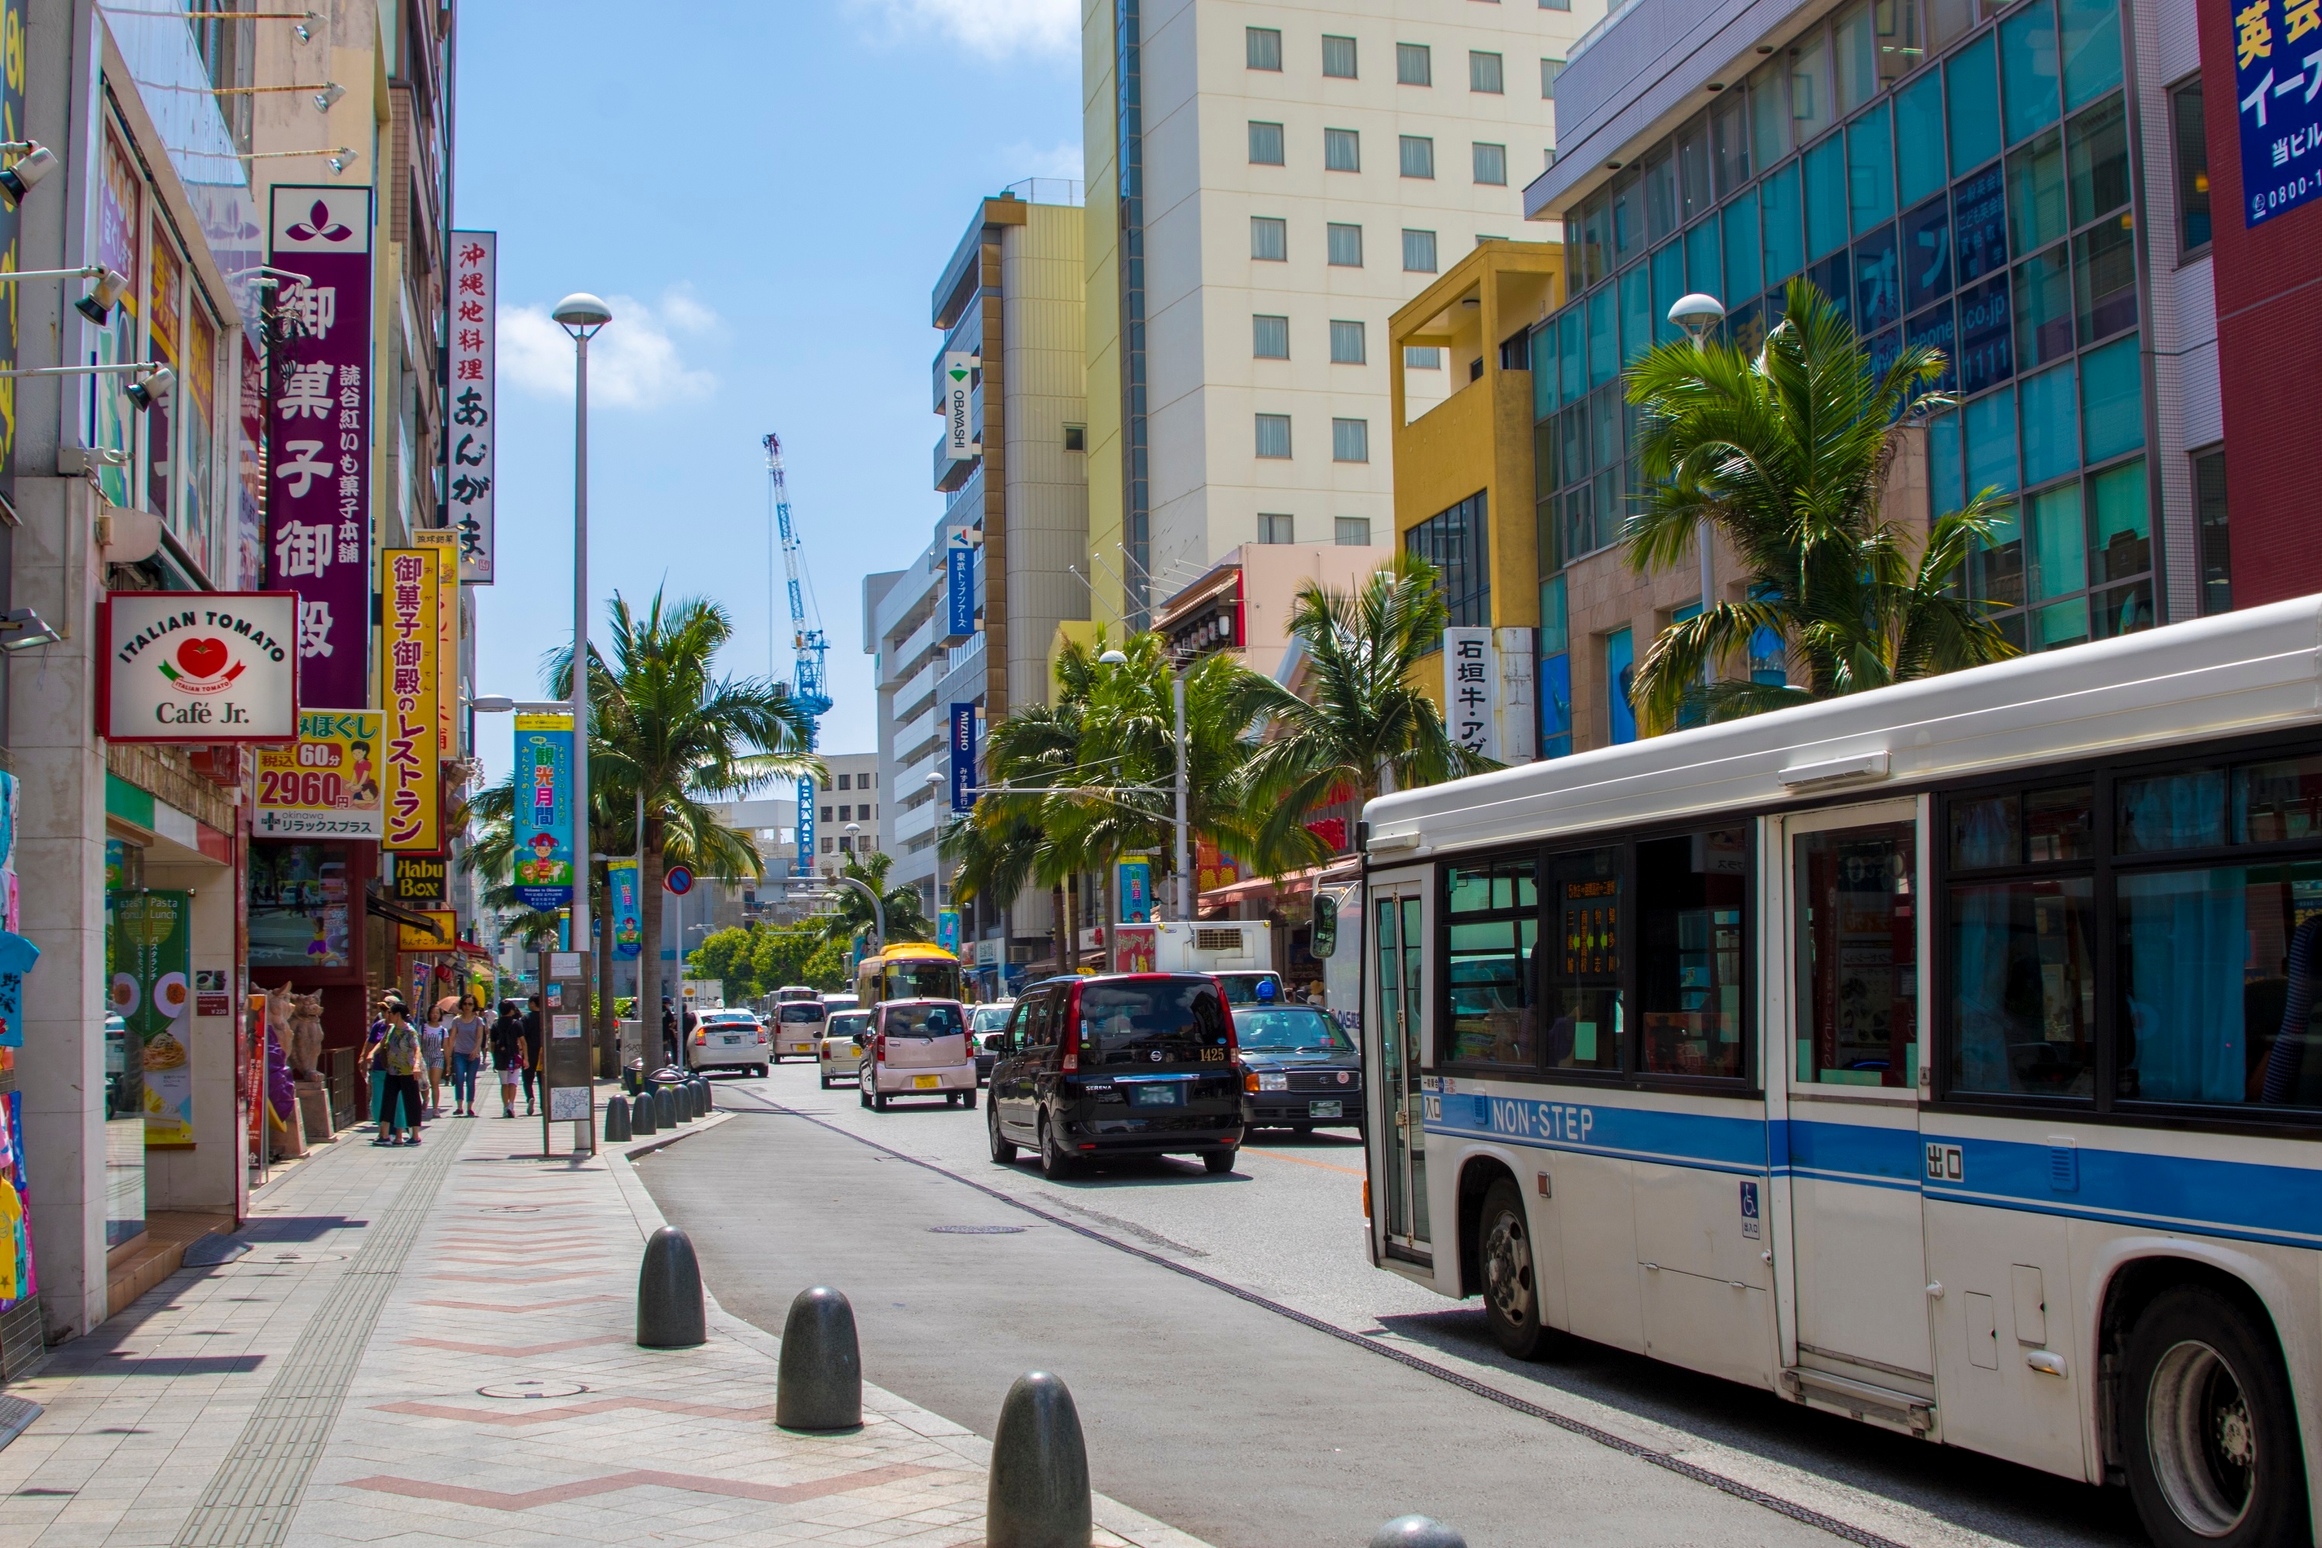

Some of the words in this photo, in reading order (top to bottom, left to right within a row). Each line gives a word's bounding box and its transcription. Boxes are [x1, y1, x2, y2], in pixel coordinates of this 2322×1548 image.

[457, 242, 486, 381] 沖縄地料理
[953, 390, 965, 448] OBAYASHI
[338, 364, 360, 563] 読谷紅いも菓子本舗
[956, 552, 968, 628] 東武トップツアーズ
[118, 611, 196, 664] ITALIAN
[206, 611, 285, 662] TOMATO
[175, 681, 200, 692] ITALIAN
[202, 681, 230, 692] TOMATO
[389, 554, 426, 843] 御菓子御殿のレストラン
[156, 702, 212, 724] Café
[220, 702, 249, 724] Jr.
[960, 711, 969, 751] MIZUHO
[261, 756, 295, 768] 税込
[260, 771, 349, 808] 2960円
[282, 812, 324, 820] okinawa
[282, 820, 372, 833] リラックスプラス
[396, 860, 443, 878] Habu
[400, 878, 439, 897] Box
[150, 898, 178, 908] Pasta
[150, 910, 178, 919] Lunch
[1200, 1048, 1225, 1062] 1425
[1425, 1096, 1441, 1118] 入口
[1492, 1099, 1594, 1142] NON-STEP
[1927, 1143, 1963, 1180] 出口
